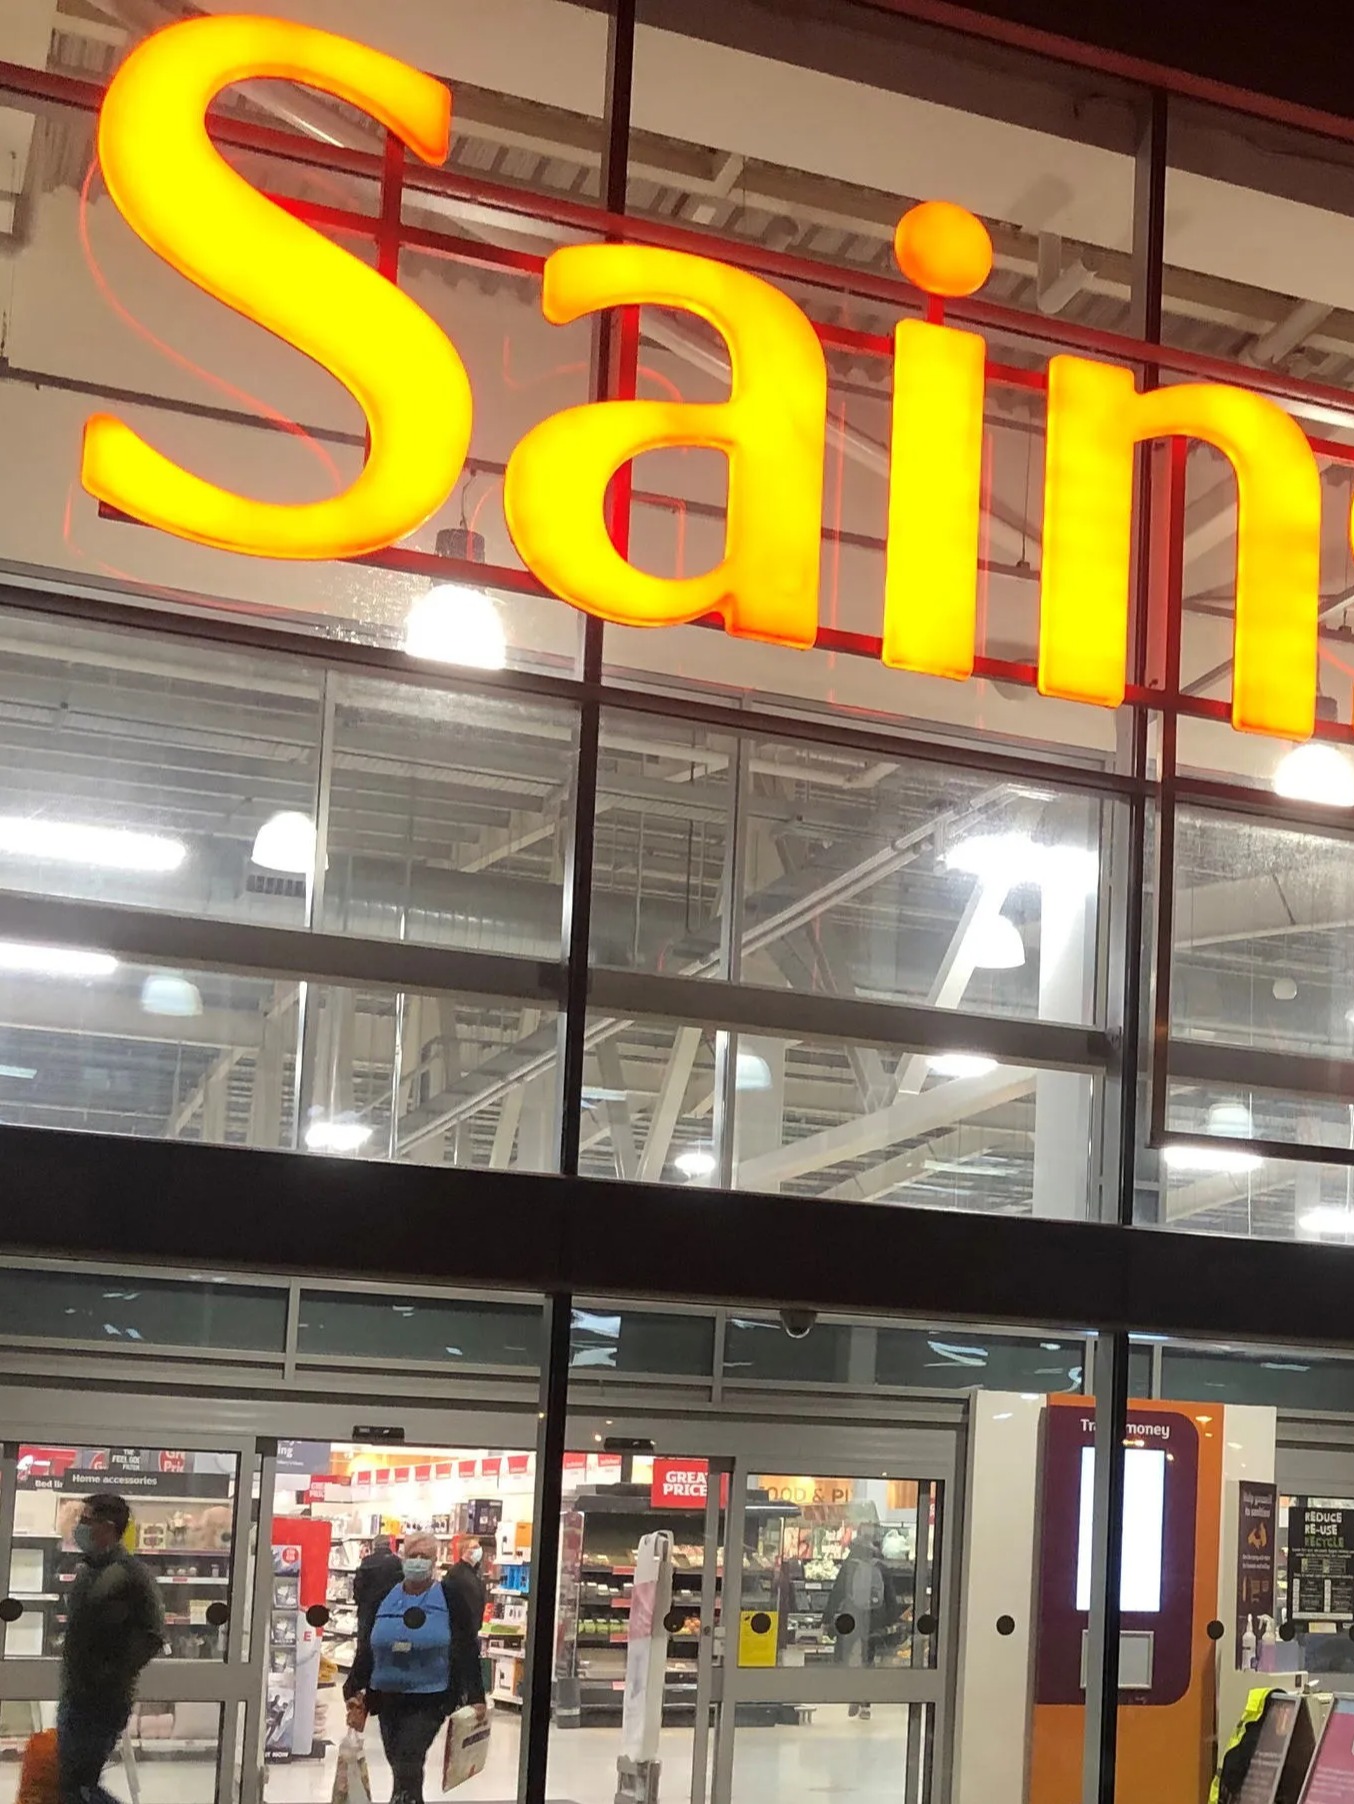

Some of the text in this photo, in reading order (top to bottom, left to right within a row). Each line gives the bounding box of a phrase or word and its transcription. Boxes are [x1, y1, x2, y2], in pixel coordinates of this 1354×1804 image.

[1126, 1423, 1170, 1439] money
[35, 1479, 52, 1489] Bed
[72, 1474, 158, 1486] Home accessories
[762, 1486, 806, 1502] OOD
[831, 1488, 850, 1503] PI
[1304, 1510, 1342, 1523] REDUCE
[1304, 1523, 1338, 1536] RE-USE
[1304, 1536, 1345, 1548] RECYCLE
